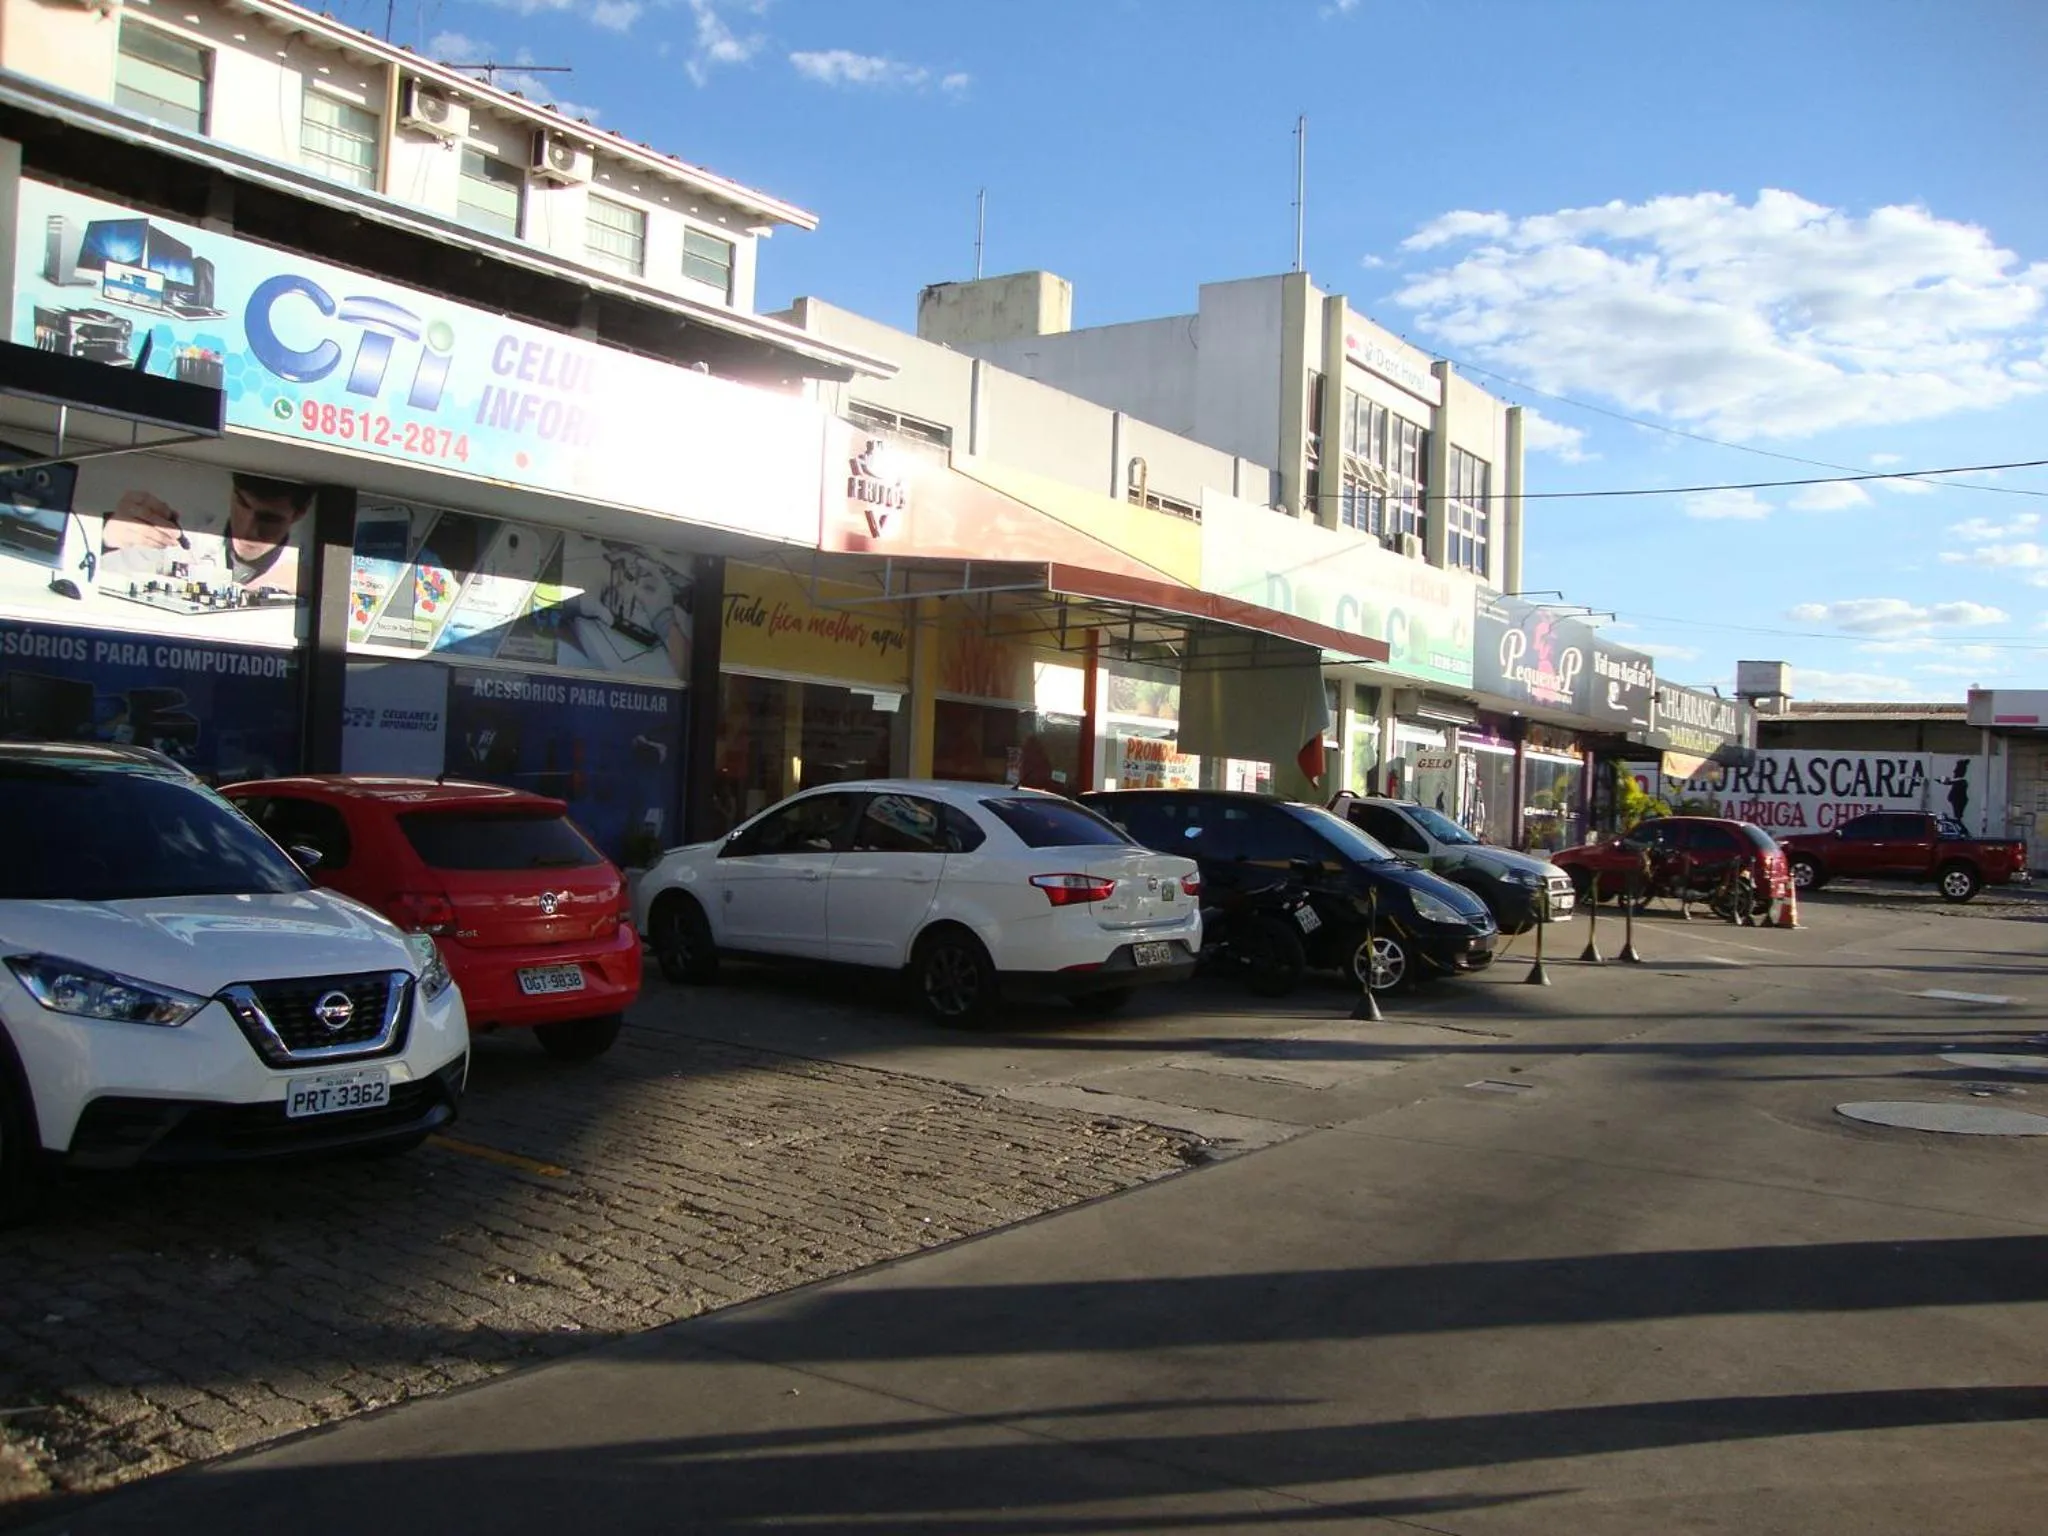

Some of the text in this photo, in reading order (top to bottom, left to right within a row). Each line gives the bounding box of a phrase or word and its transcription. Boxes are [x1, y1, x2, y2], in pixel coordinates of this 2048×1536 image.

[301, 400, 469, 462] 98512-2874
[722, 592, 767, 628] Tudo
[768, 602, 802, 637] fica
[808, 611, 869, 648] melhor
[94, 641, 149, 667] PARA
[154, 645, 289, 679] COMPUTADOR
[569, 687, 606, 707] PARA
[609, 691, 668, 713] CELULAR
[1417, 757, 1453, 770] GELO
[1718, 800, 1807, 828] ARRIGA
